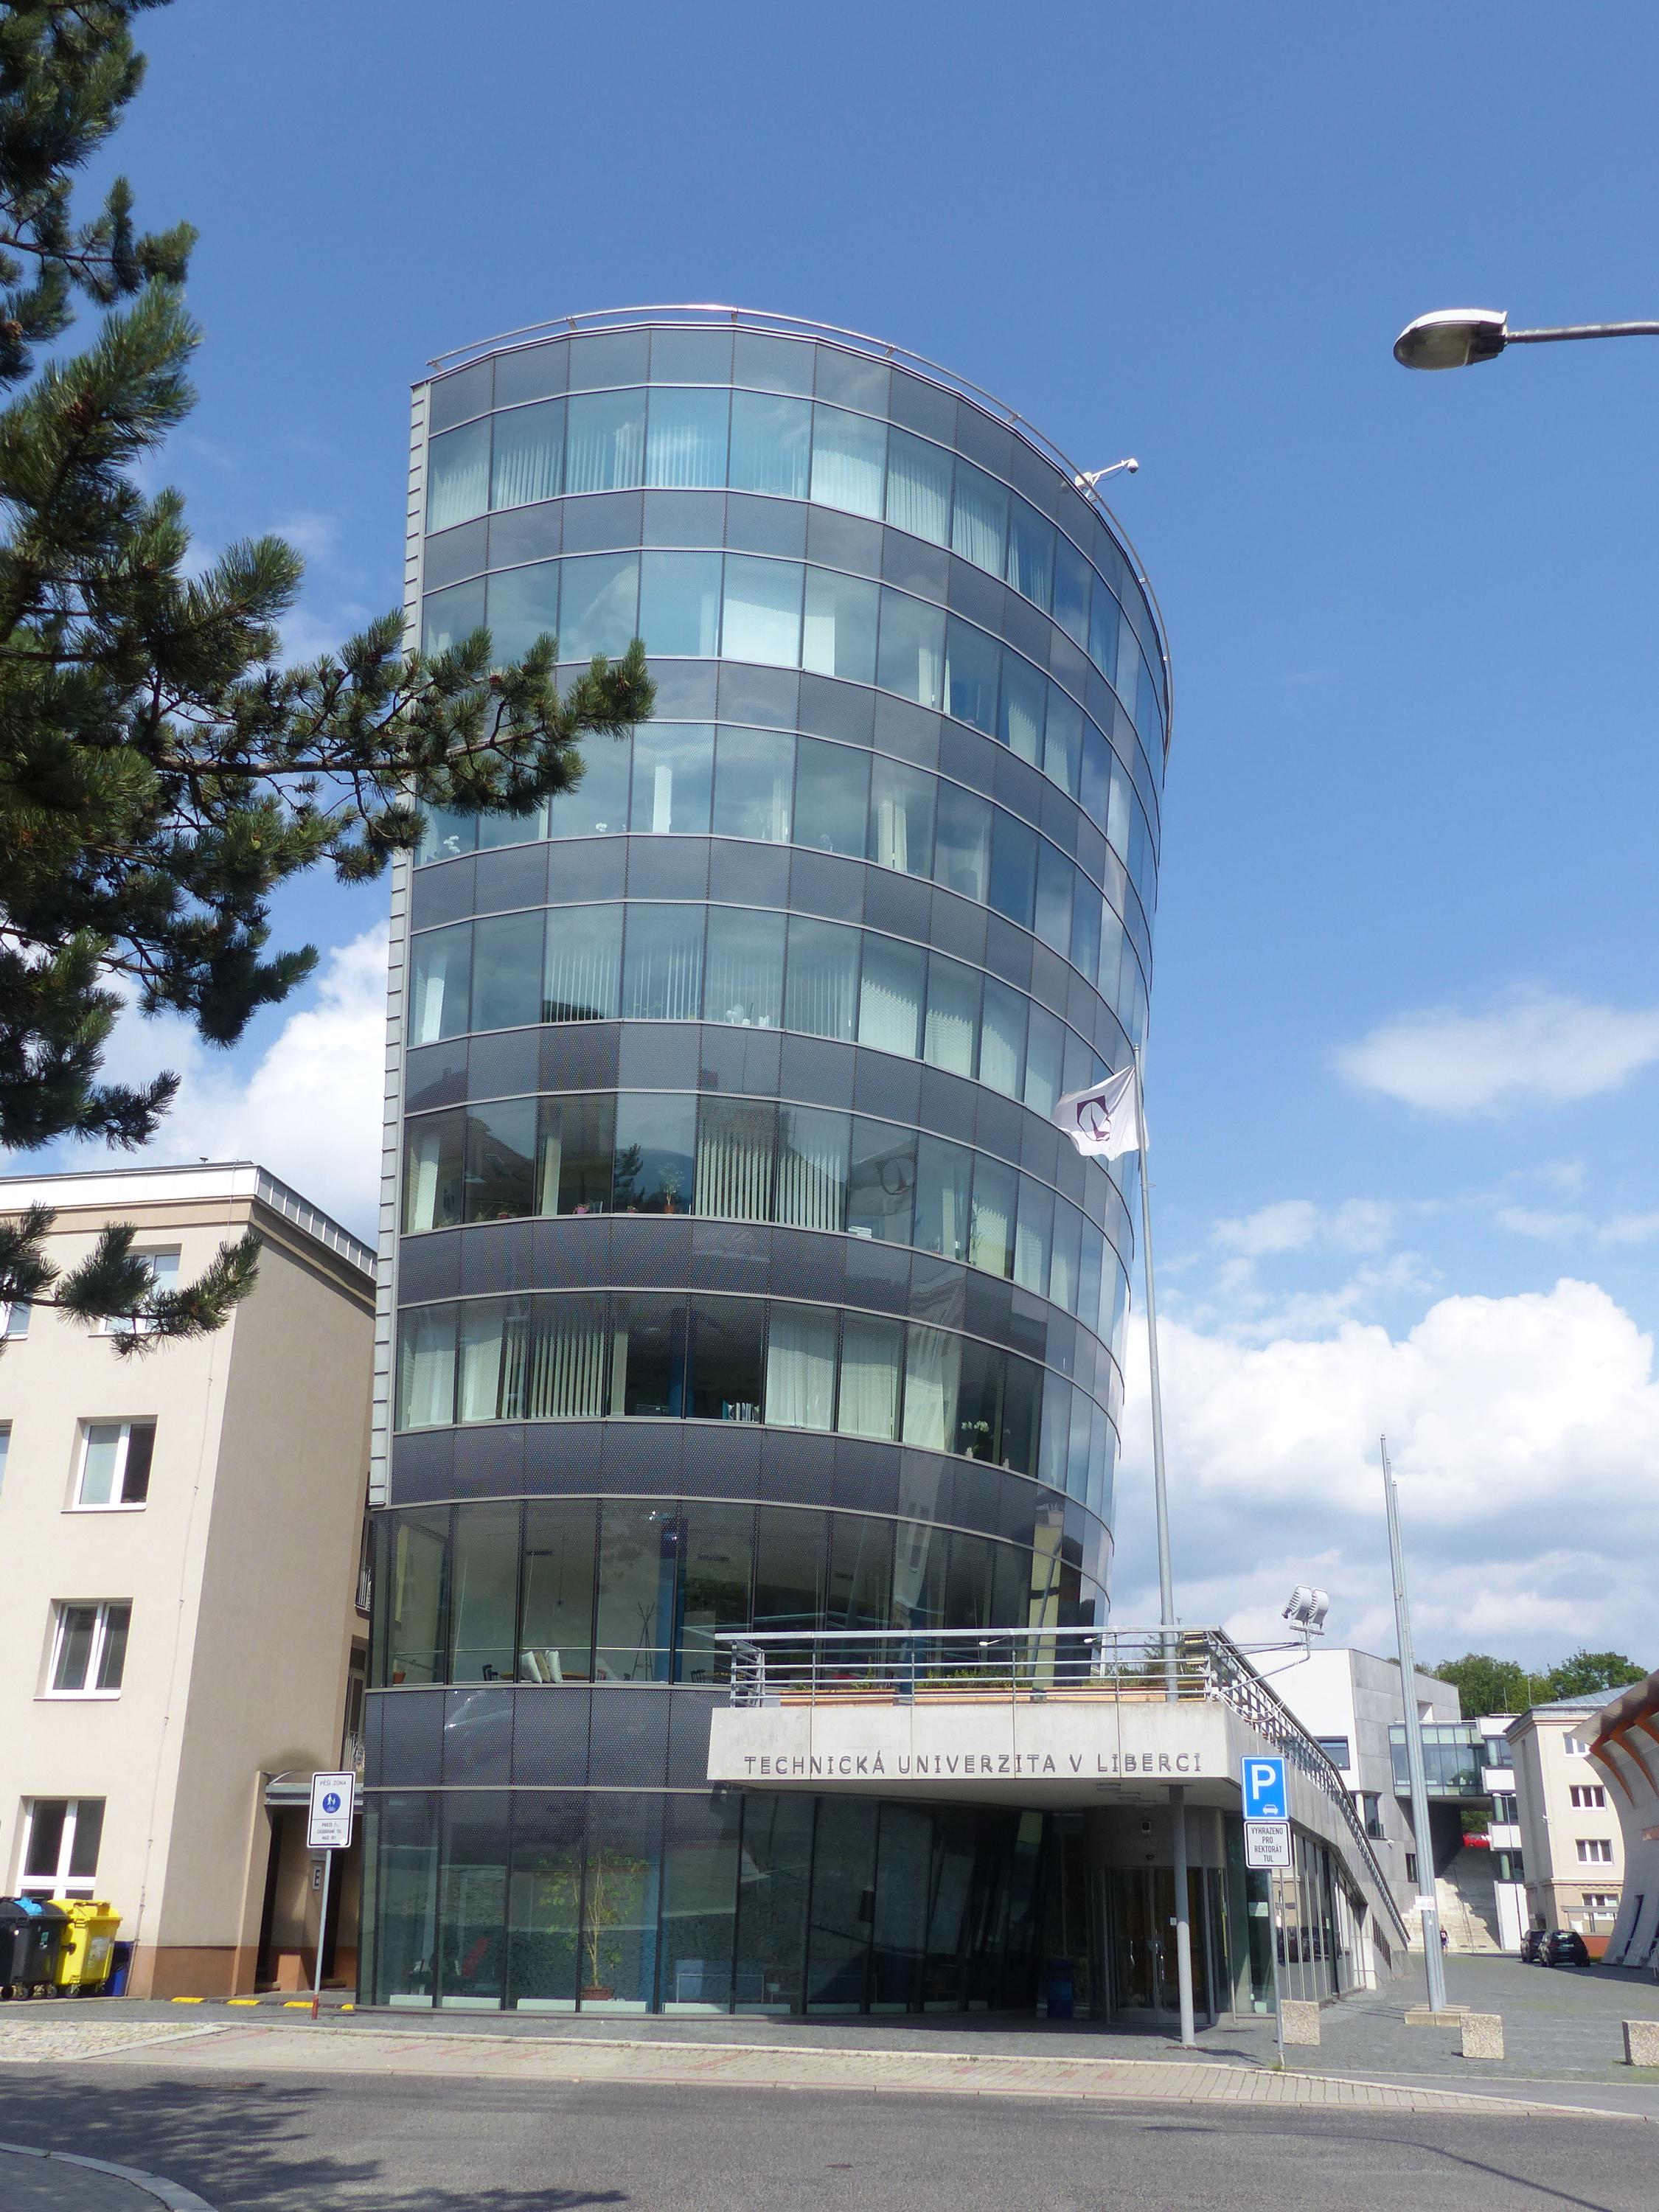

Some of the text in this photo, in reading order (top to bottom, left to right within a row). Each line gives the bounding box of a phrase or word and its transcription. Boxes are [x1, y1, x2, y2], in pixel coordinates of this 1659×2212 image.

[744, 1750, 1201, 1775] TECHNICKÁ UNIVERZITA V LIBERCI
[1251, 1764, 1276, 1800] P
[1251, 1827, 1284, 1835] VYHRAZENO
[1262, 1836, 1273, 1844] PRO
[1254, 1844, 1282, 1853] REKTORÁT
[1263, 1854, 1274, 1863] TUL
